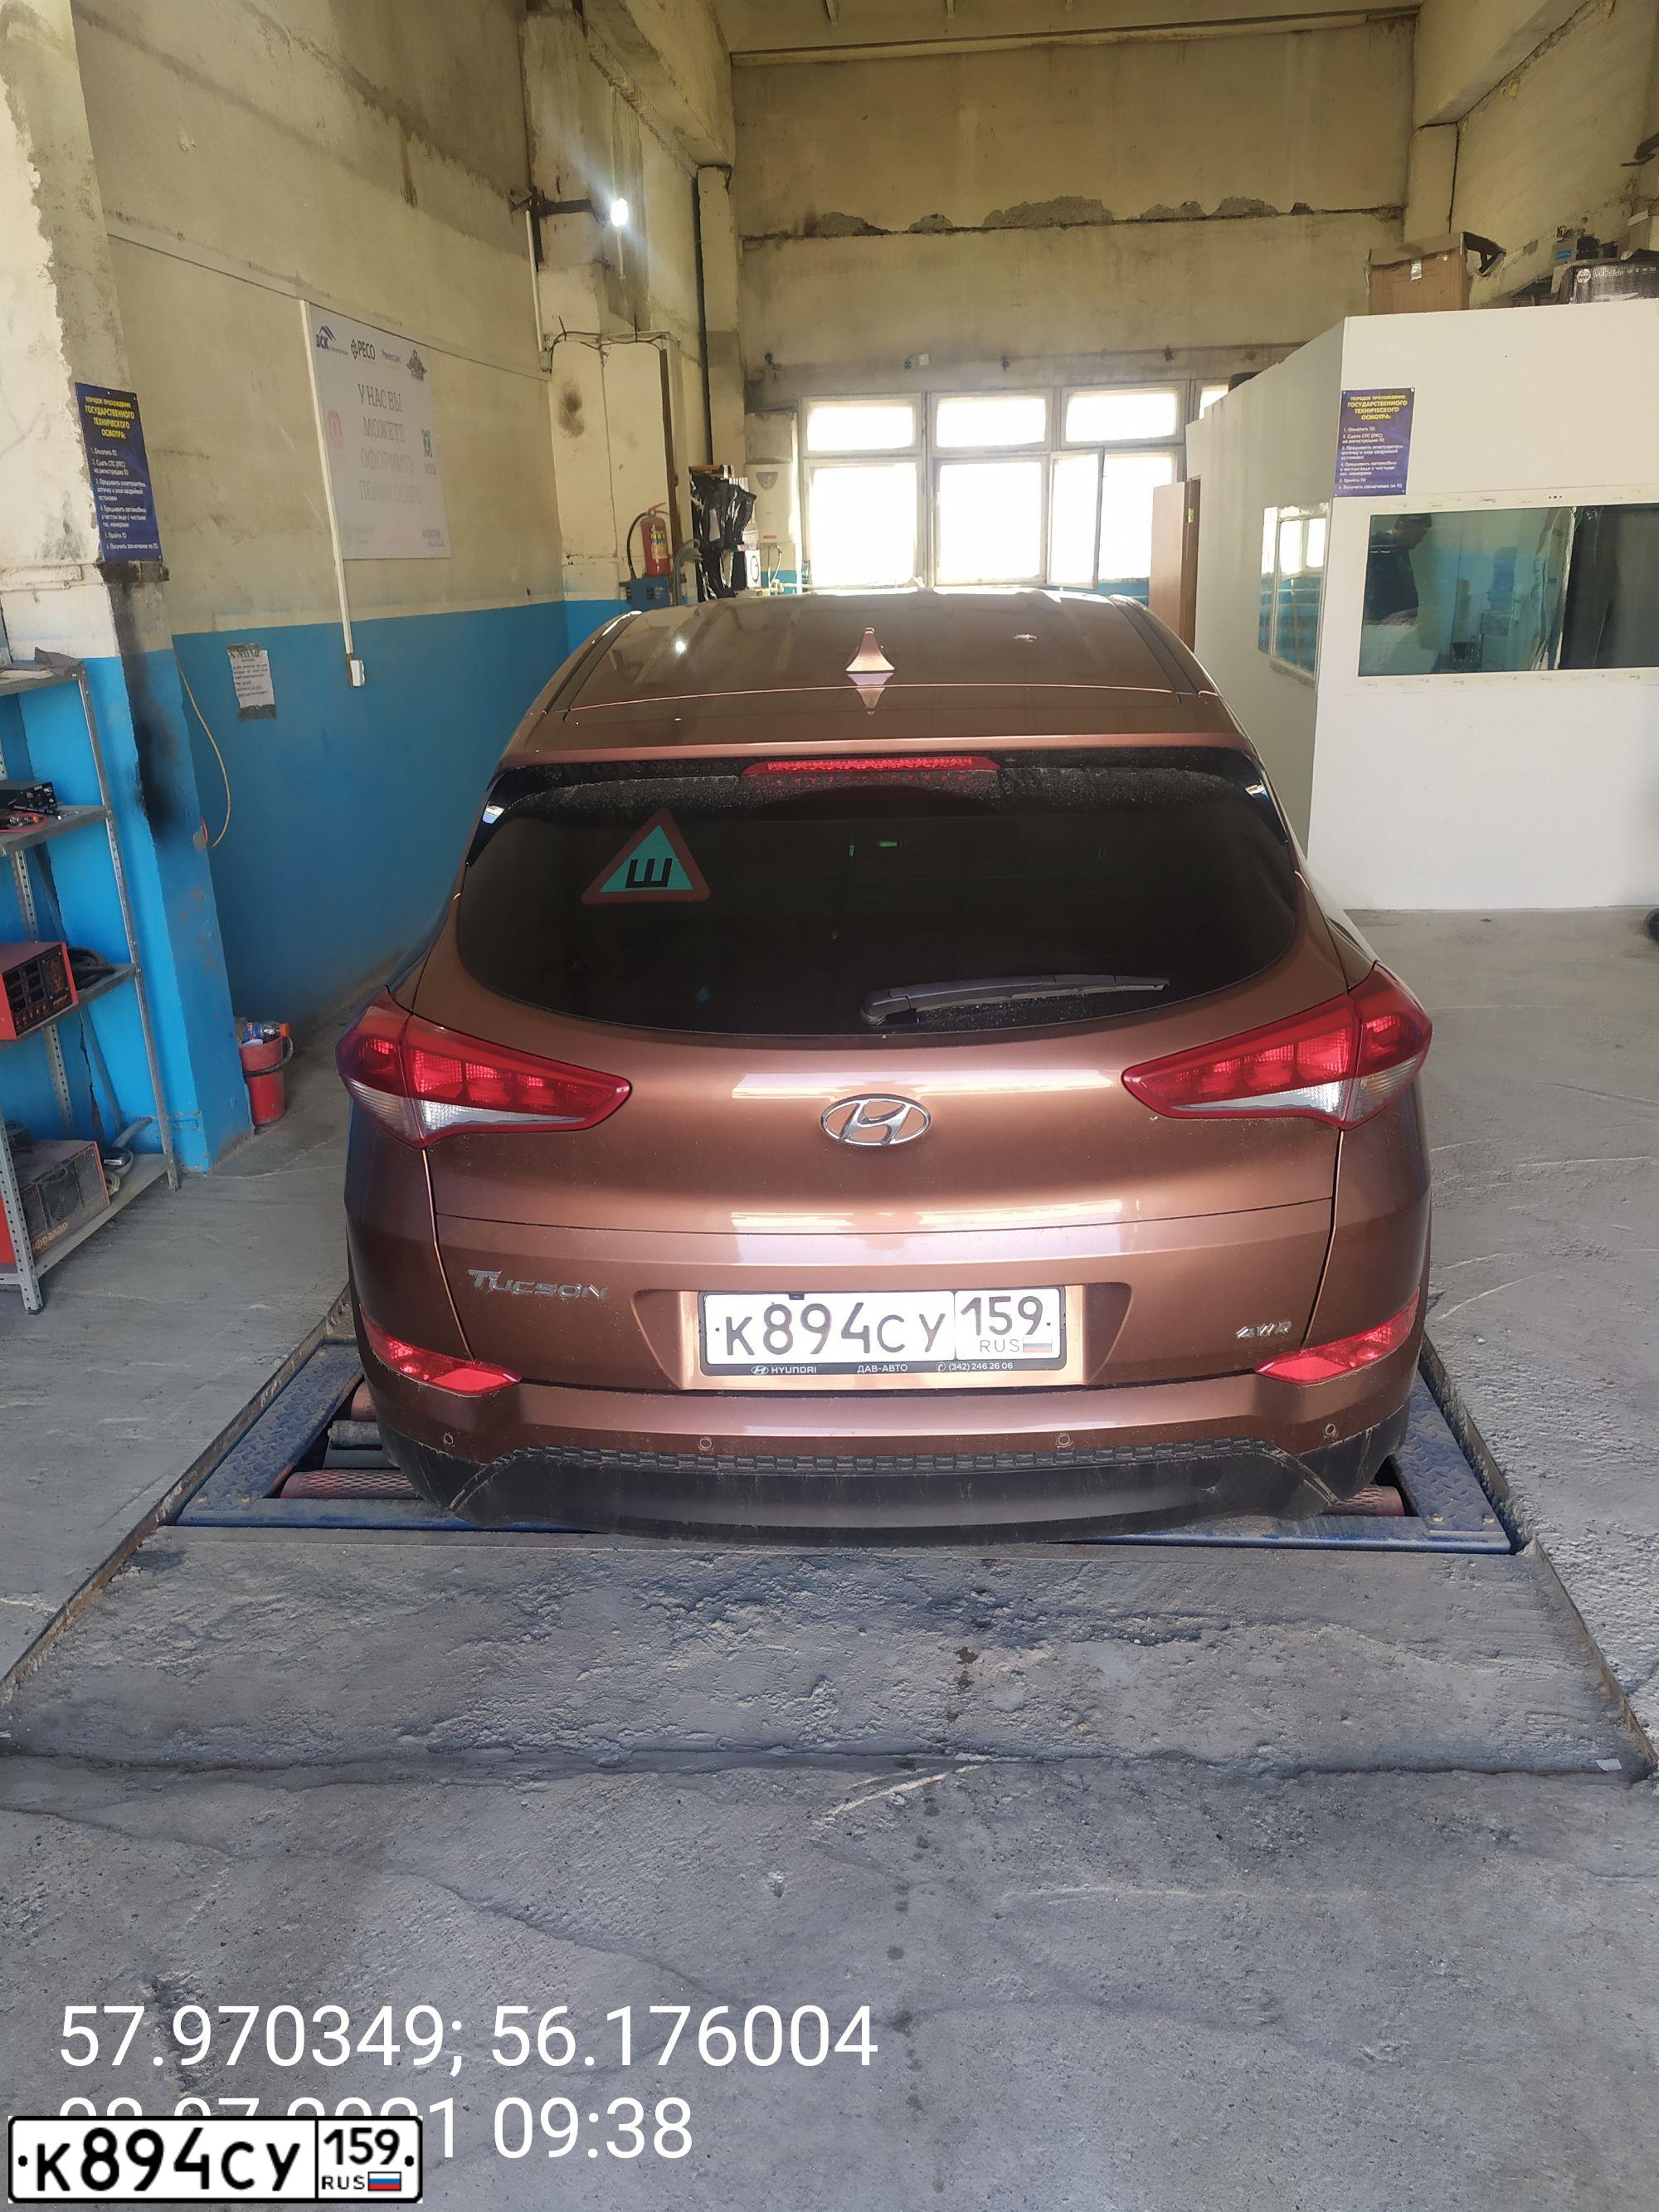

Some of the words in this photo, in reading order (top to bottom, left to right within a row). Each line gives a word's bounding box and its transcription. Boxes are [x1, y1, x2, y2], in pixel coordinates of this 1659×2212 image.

[358, 340, 376, 360] РЕСО
[358, 383, 364, 404] У
[367, 385, 387, 409] НАС
[387, 391, 403, 412] ВЫ
[85, 404, 135, 420] ГОСУДАРСТВЕННОГО
[93, 417, 130, 429] ТЕХНИЧЕСКОГО
[362, 417, 406, 443] МОЖЕТЕ
[625, 858, 673, 888] Ш
[468, 1269, 608, 1299] TUCSON
[961, 1295, 1044, 1336] 159
[980, 1338, 1020, 1353] RUS
[771, 1366, 817, 1374] HYUNDAI
[857, 1363, 908, 1374] ДАВ-АВТО
[948, 1362, 971, 1372] (342)
[971, 1362, 987, 1371] 246
[989, 1362, 1000, 1370] 26
[1001, 1362, 1014, 1370] 06
